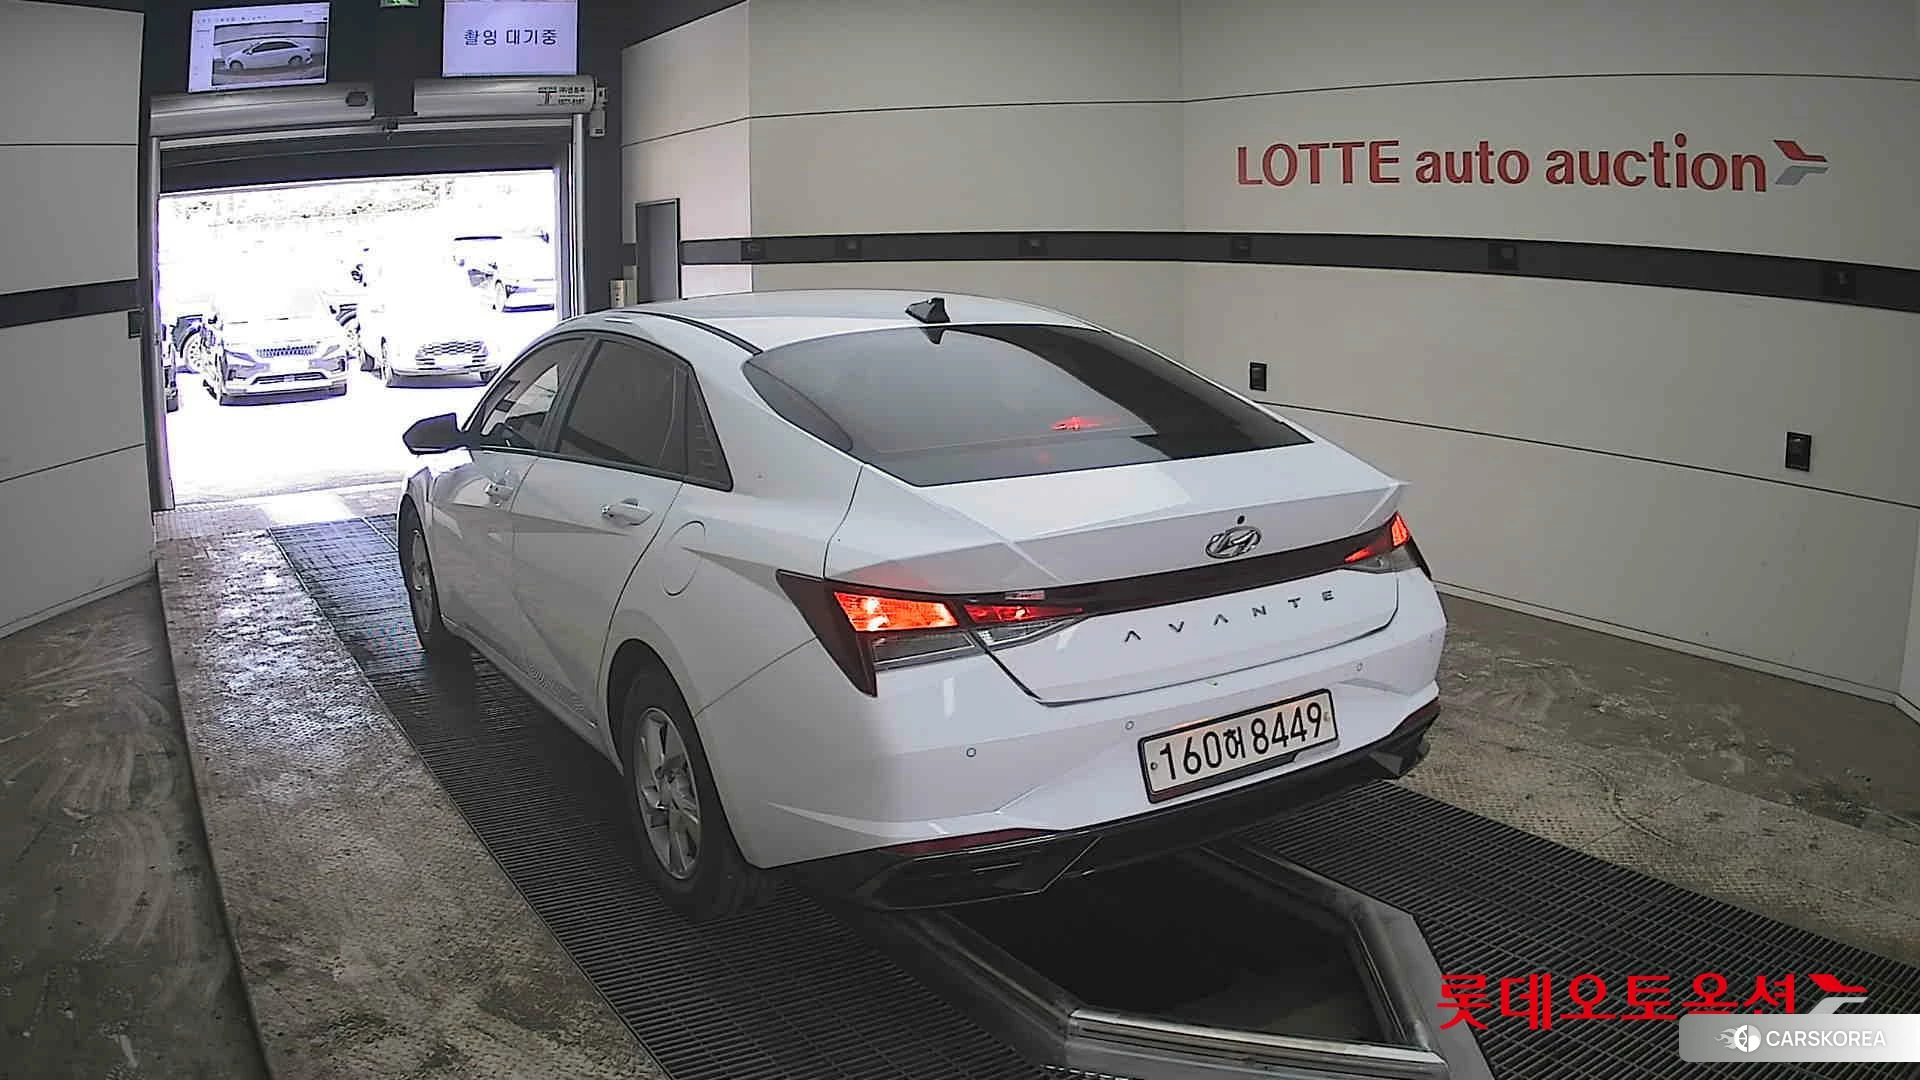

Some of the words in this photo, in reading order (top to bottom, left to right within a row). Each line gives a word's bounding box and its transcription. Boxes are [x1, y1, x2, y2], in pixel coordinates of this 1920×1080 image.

[505, 29, 558, 46] 대기중
[1236, 140, 1400, 187] LOTTE
[1415, 140, 1531, 186] auto
[1545, 132, 1766, 192] auction
[1123, 589, 1335, 643] AVANTE
